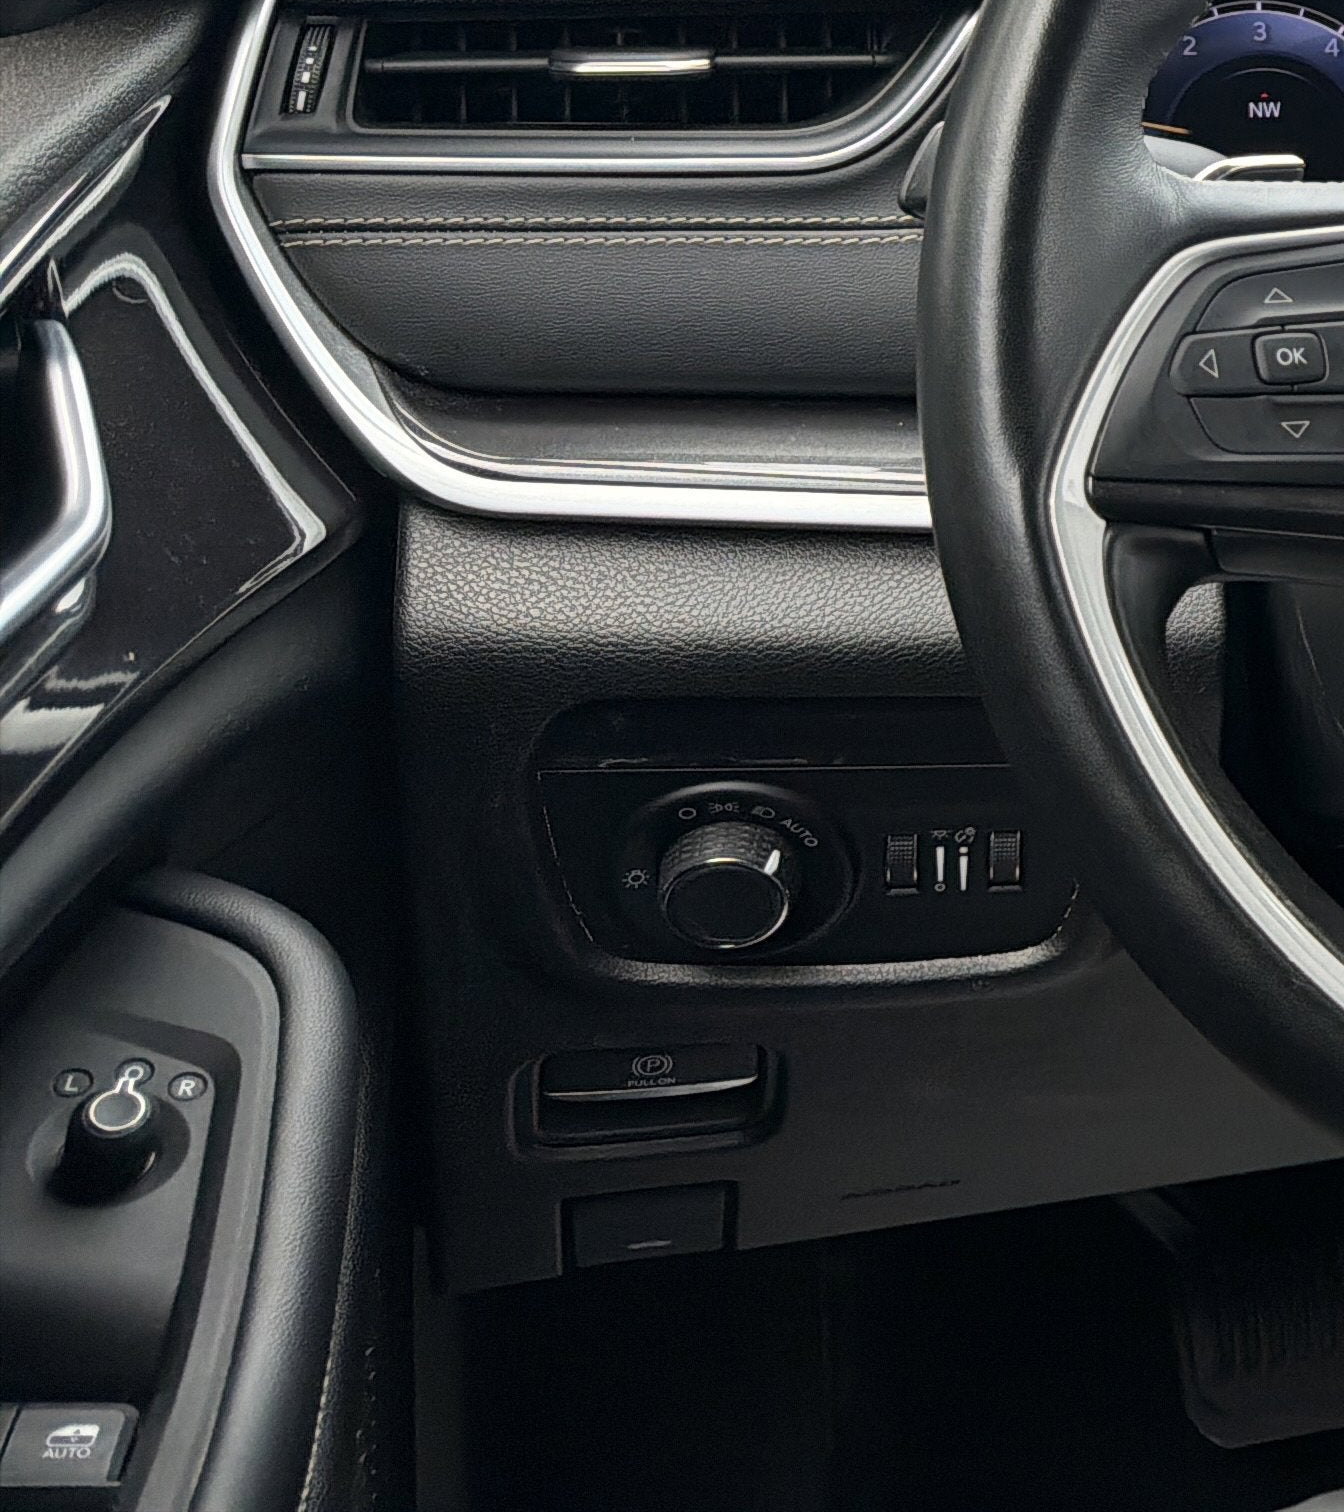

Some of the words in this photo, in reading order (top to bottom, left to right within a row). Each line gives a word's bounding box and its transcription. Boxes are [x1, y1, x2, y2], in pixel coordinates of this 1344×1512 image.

[1253, 21, 1267, 41] 3
[1182, 36, 1197, 55] 2
[1324, 39, 1340, 57] 4
[1248, 101, 1281, 118] NW
[1276, 348, 1308, 365] OK
[780, 818, 818, 847] AUTO
[63, 1074, 79, 1092] L
[177, 1079, 196, 1096] R
[657, 1077, 676, 1085] ON
[43, 1446, 91, 1459] AUTO
